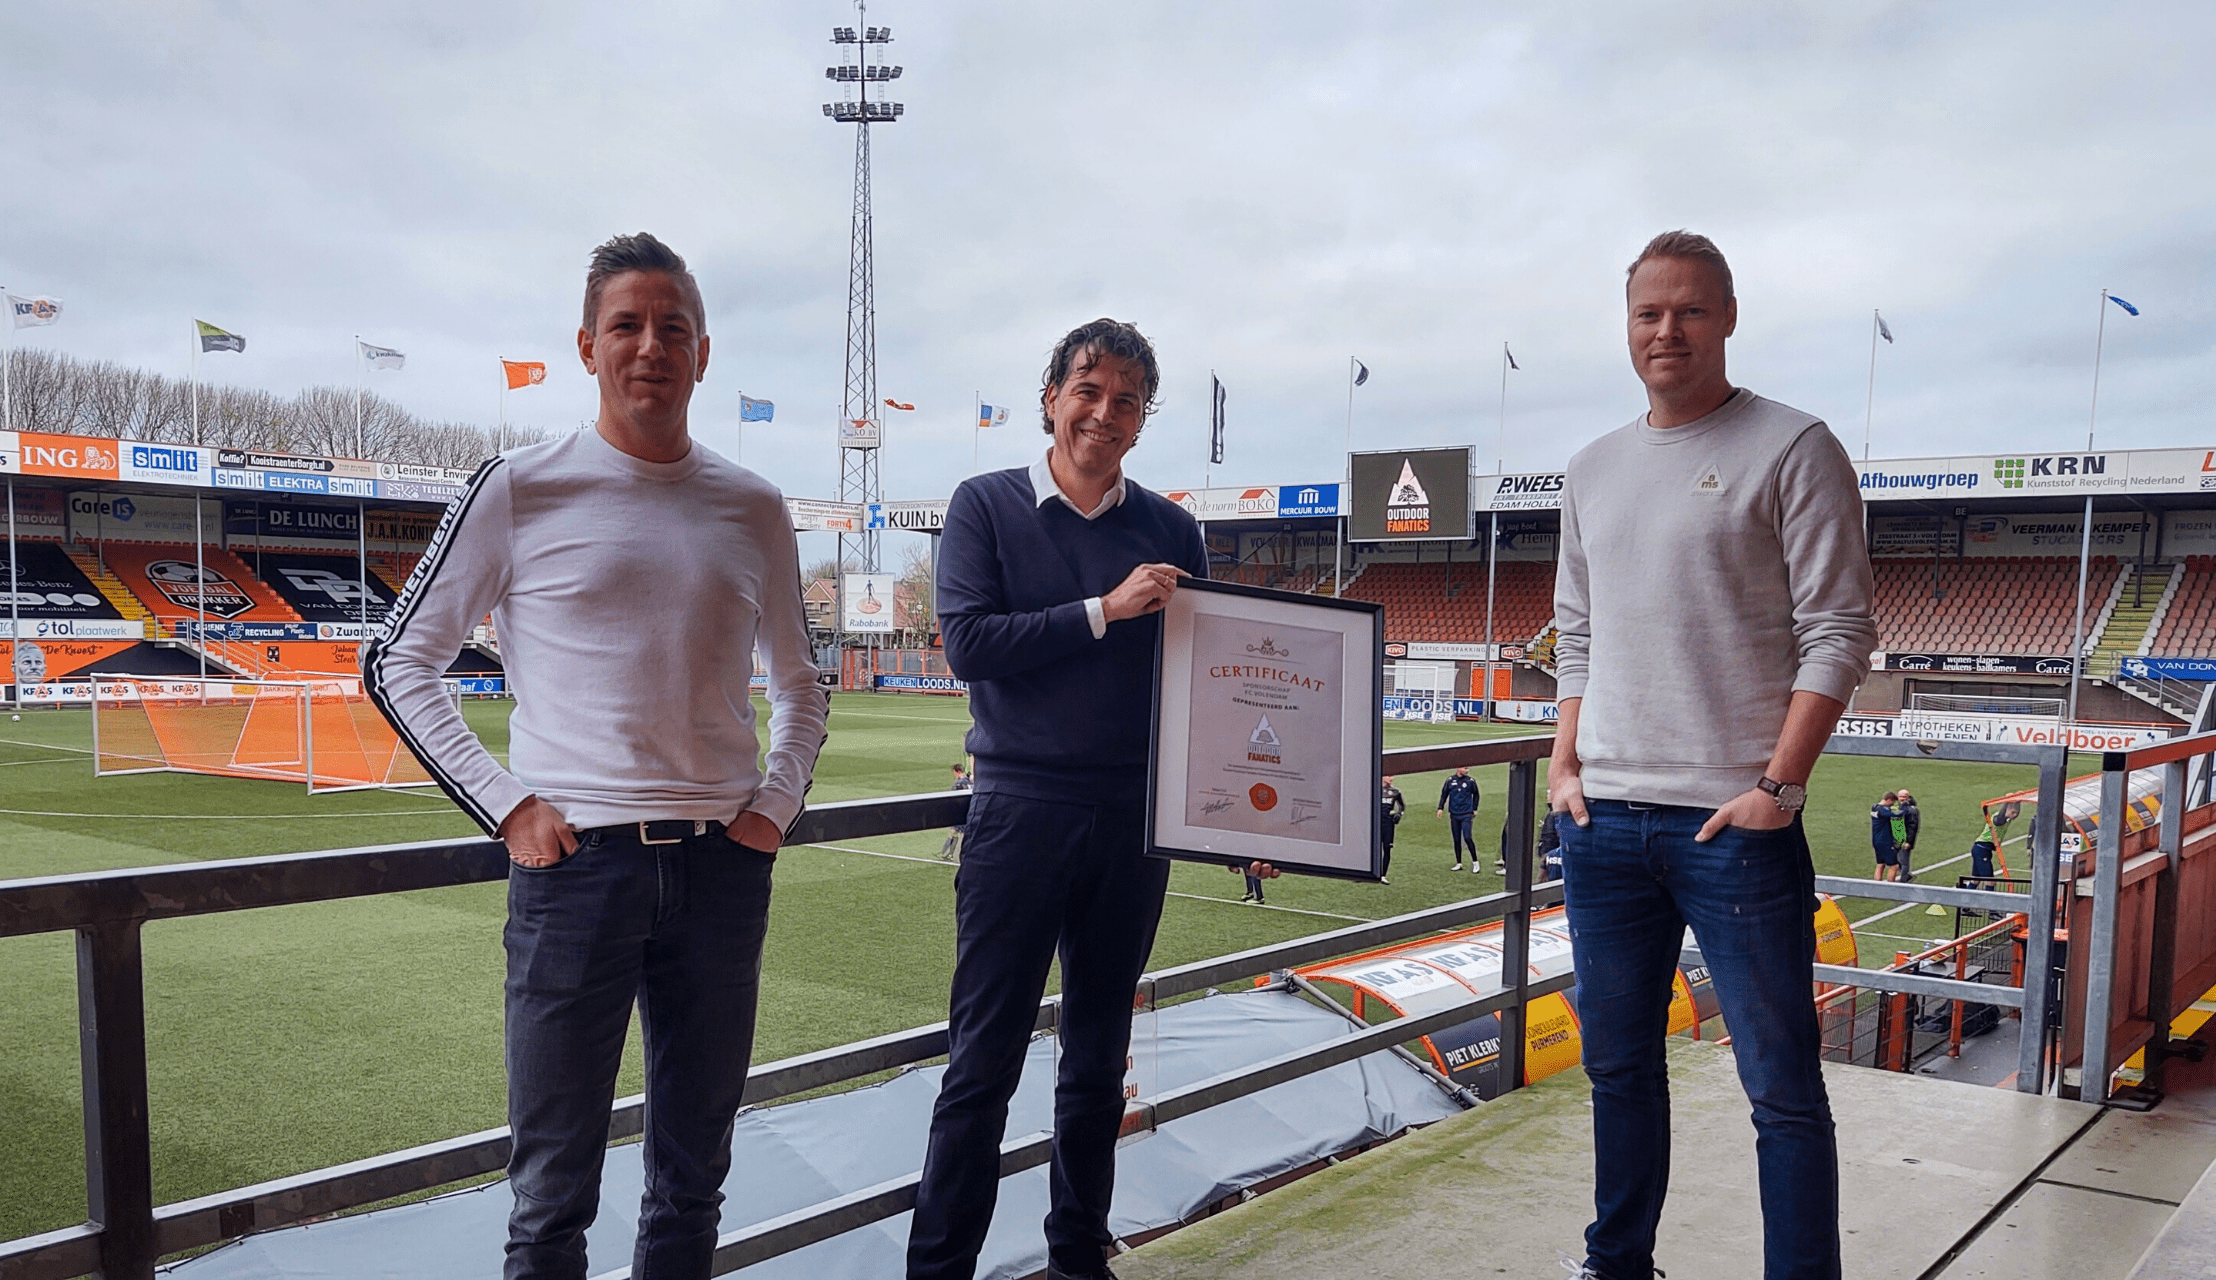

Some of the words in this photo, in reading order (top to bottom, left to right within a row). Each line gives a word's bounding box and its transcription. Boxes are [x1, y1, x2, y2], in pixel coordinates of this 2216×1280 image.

[22, 445, 78, 468] ING
[134, 449, 197, 471] smit
[219, 453, 244, 464] Koffie?
[397, 463, 438, 477] Leinster
[443, 469, 472, 479] Enviro
[2031, 455, 2106, 477] KRN
[132, 470, 199, 481] ELEKTROTECHNIEK
[1859, 472, 1979, 490] Afbouwgroep
[2027, 478, 2076, 488] Kunststof
[2079, 476, 2127, 489] Recycling
[2130, 475, 2185, 486] Nederland
[217, 472, 263, 488] smit
[269, 476, 324, 491] ELEKTRA
[330, 480, 372, 496] smit
[422, 485, 460, 496] TEGELZET
[71, 498, 110, 515] Care
[1238, 499, 1276, 511] BOKO
[1280, 506, 1313, 515] MERCUUR
[1314, 505, 1336, 514] BOUW
[1489, 501, 1521, 509] EDAM
[1522, 500, 1562, 508] HOLLA
[269, 509, 293, 526] DE
[297, 511, 358, 530] LUNCH
[888, 510, 926, 528] KUIN
[1387, 508, 1429, 520] OUTDOOR
[1387, 519, 1430, 533] FANATICS
[2012, 524, 2076, 534] VEERMAN
[2092, 522, 2151, 533] KEMPER
[2174, 522, 2212, 531] FROZEN
[1297, 534, 1341, 548] KWAKMA
[166, 584, 234, 594] VOETBAL
[51, 620, 74, 635] tol
[76, 625, 127, 637] plaatwerk
[849, 618, 889, 628] Rabobank
[244, 628, 285, 637] RECYCLING
[1386, 646, 1404, 654] KIVO
[1899, 659, 1932, 670] Carré
[2035, 662, 2070, 674] Carré
[2157, 662, 2184, 670] VAN
[2188, 662, 2216, 671] DON
[1209, 665, 1325, 692] CERTIFICAAT
[450, 682, 477, 692] Gaaf
[1242, 682, 1291, 693] SPONSORSCHAP
[1254, 691, 1288, 700] VOLENDAM
[1232, 697, 1283, 710] GEPRESENTEERD
[1899, 721, 1981, 733] HYPOTHEKEN
[2015, 726, 2137, 750] Veldboer
[1247, 752, 1281, 765] FANATICS
[1686, 967, 1702, 983] PIET
[1530, 1029, 1569, 1052] PURMEREND
[1445, 1047, 1471, 1067] PIET
